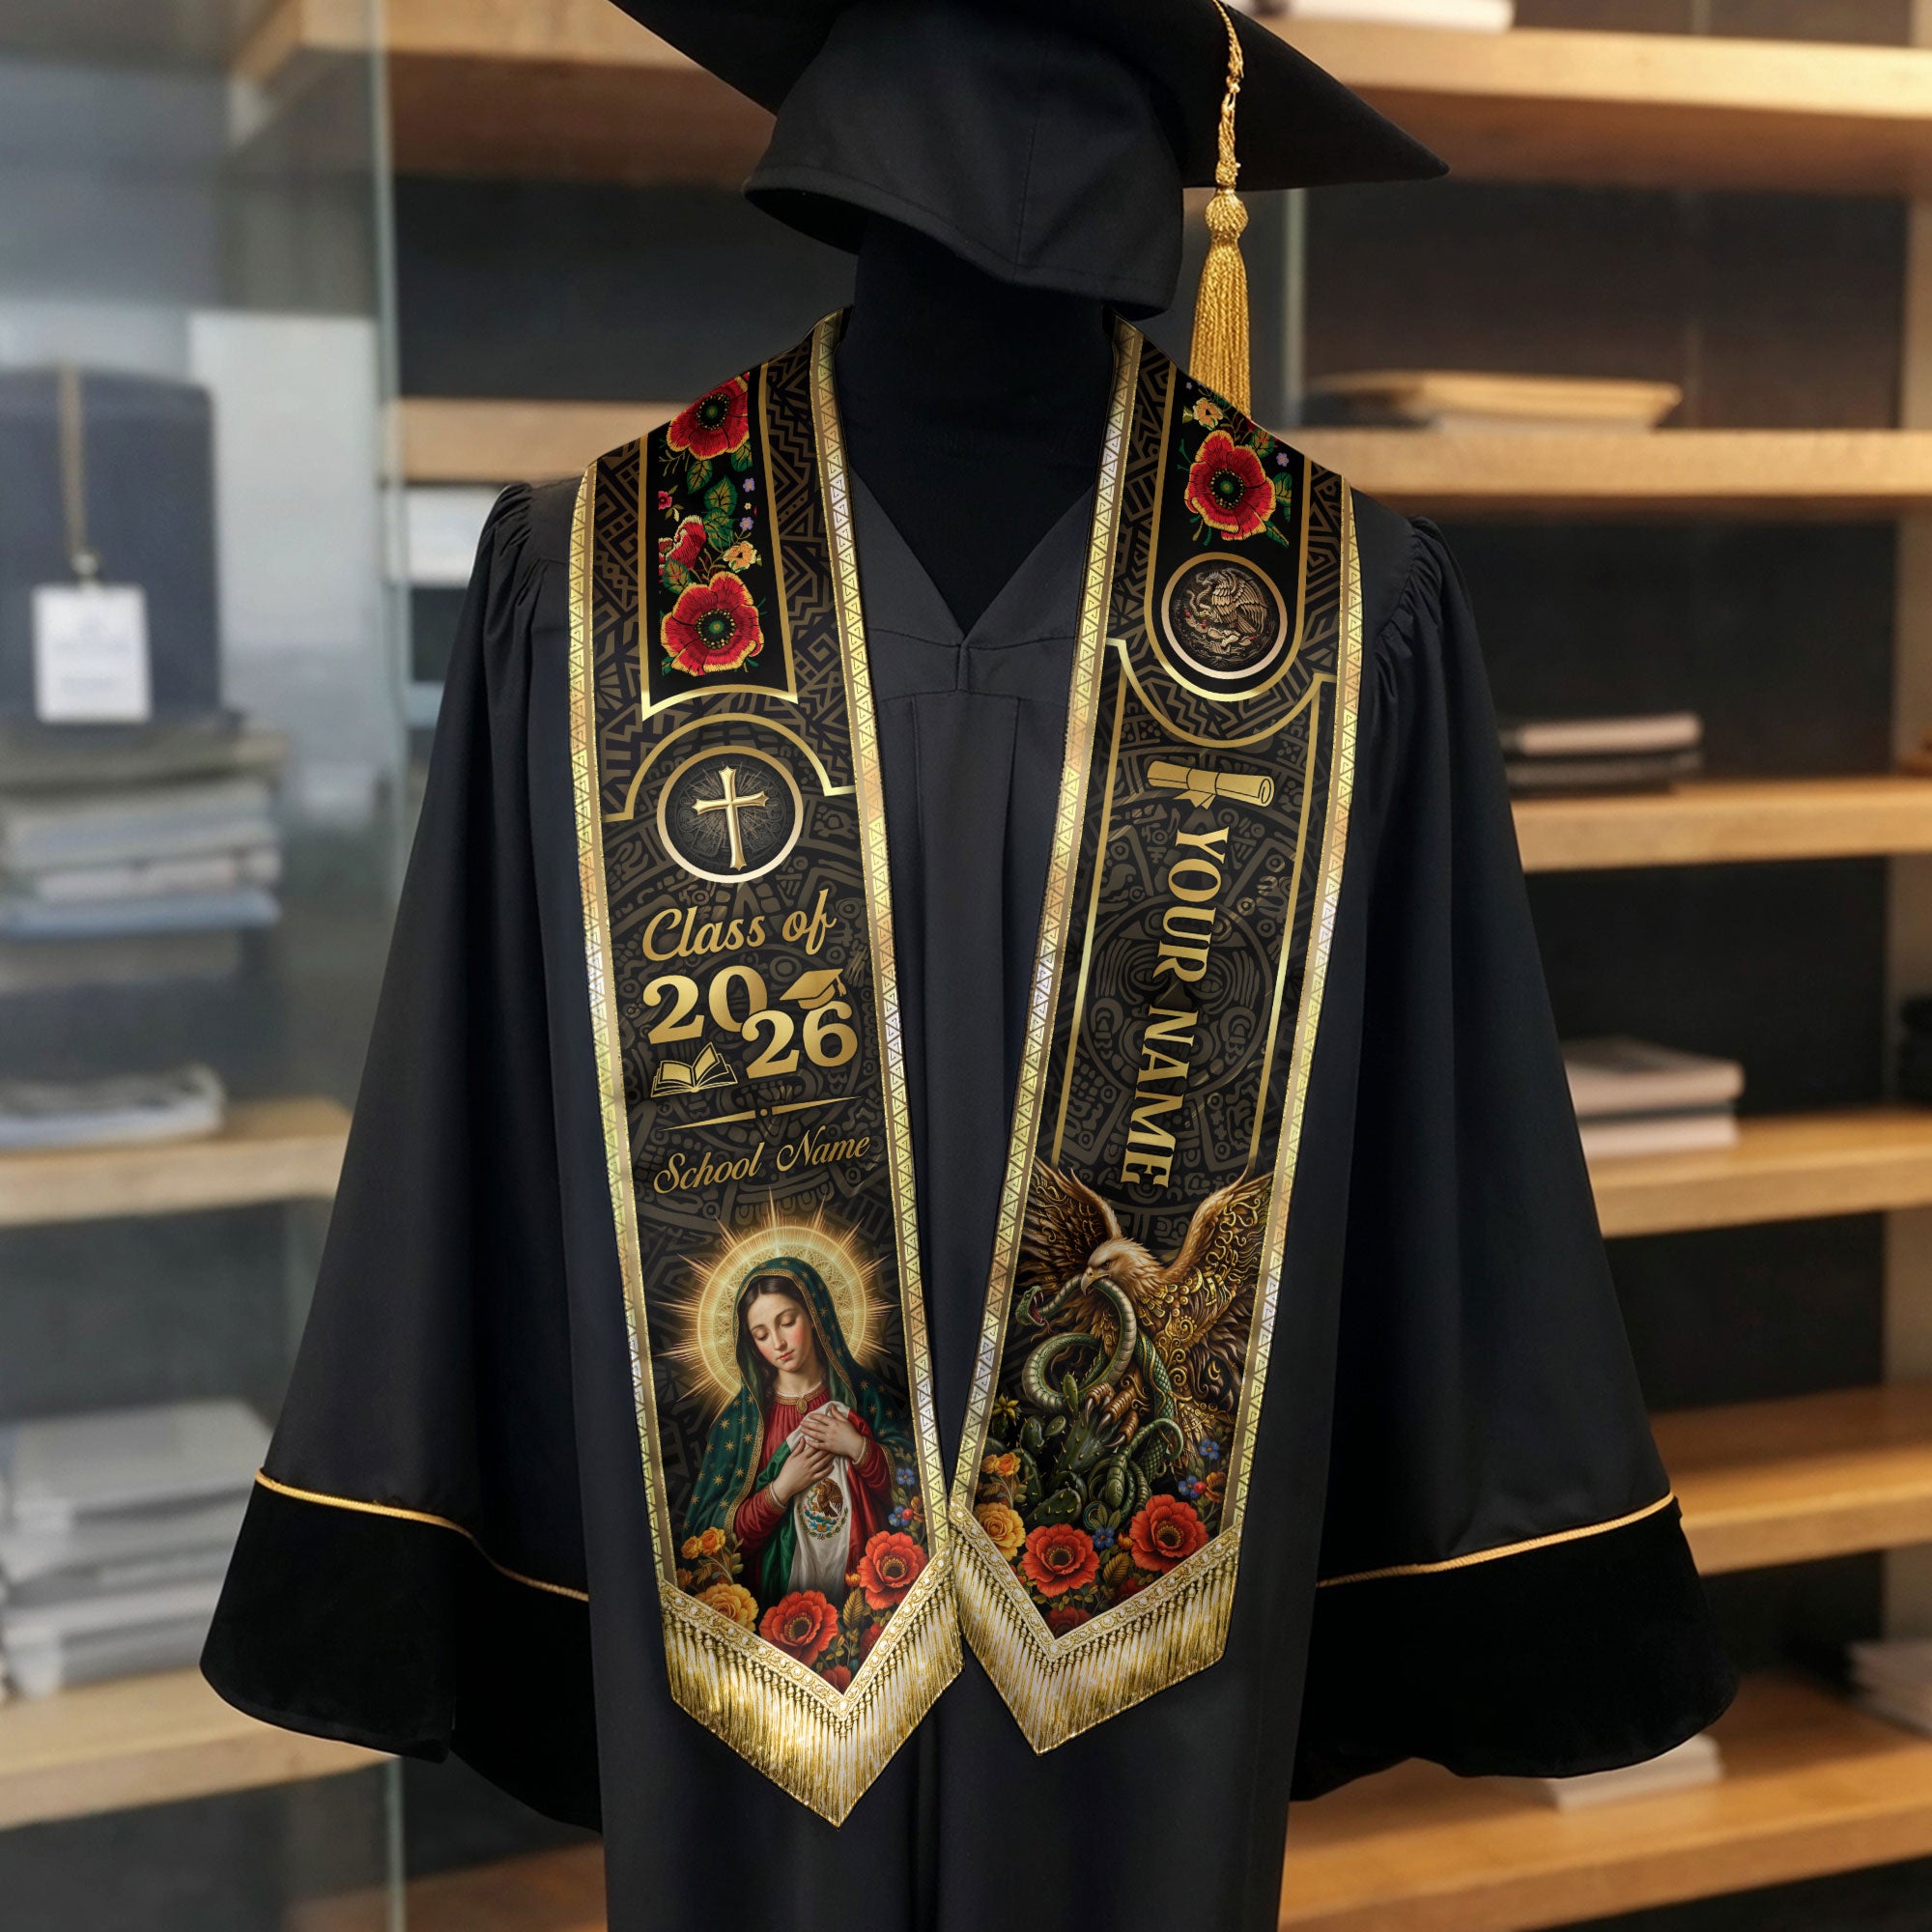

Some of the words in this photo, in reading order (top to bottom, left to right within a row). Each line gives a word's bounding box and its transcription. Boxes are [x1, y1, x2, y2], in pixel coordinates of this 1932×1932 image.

[641, 906, 766, 962] Class
[782, 889, 838, 955] of
[1152, 826, 1229, 982] YOUR
[1121, 1007, 1199, 1188] NAME
[653, 1142, 765, 1194] School
[776, 1125, 870, 1172] Name
